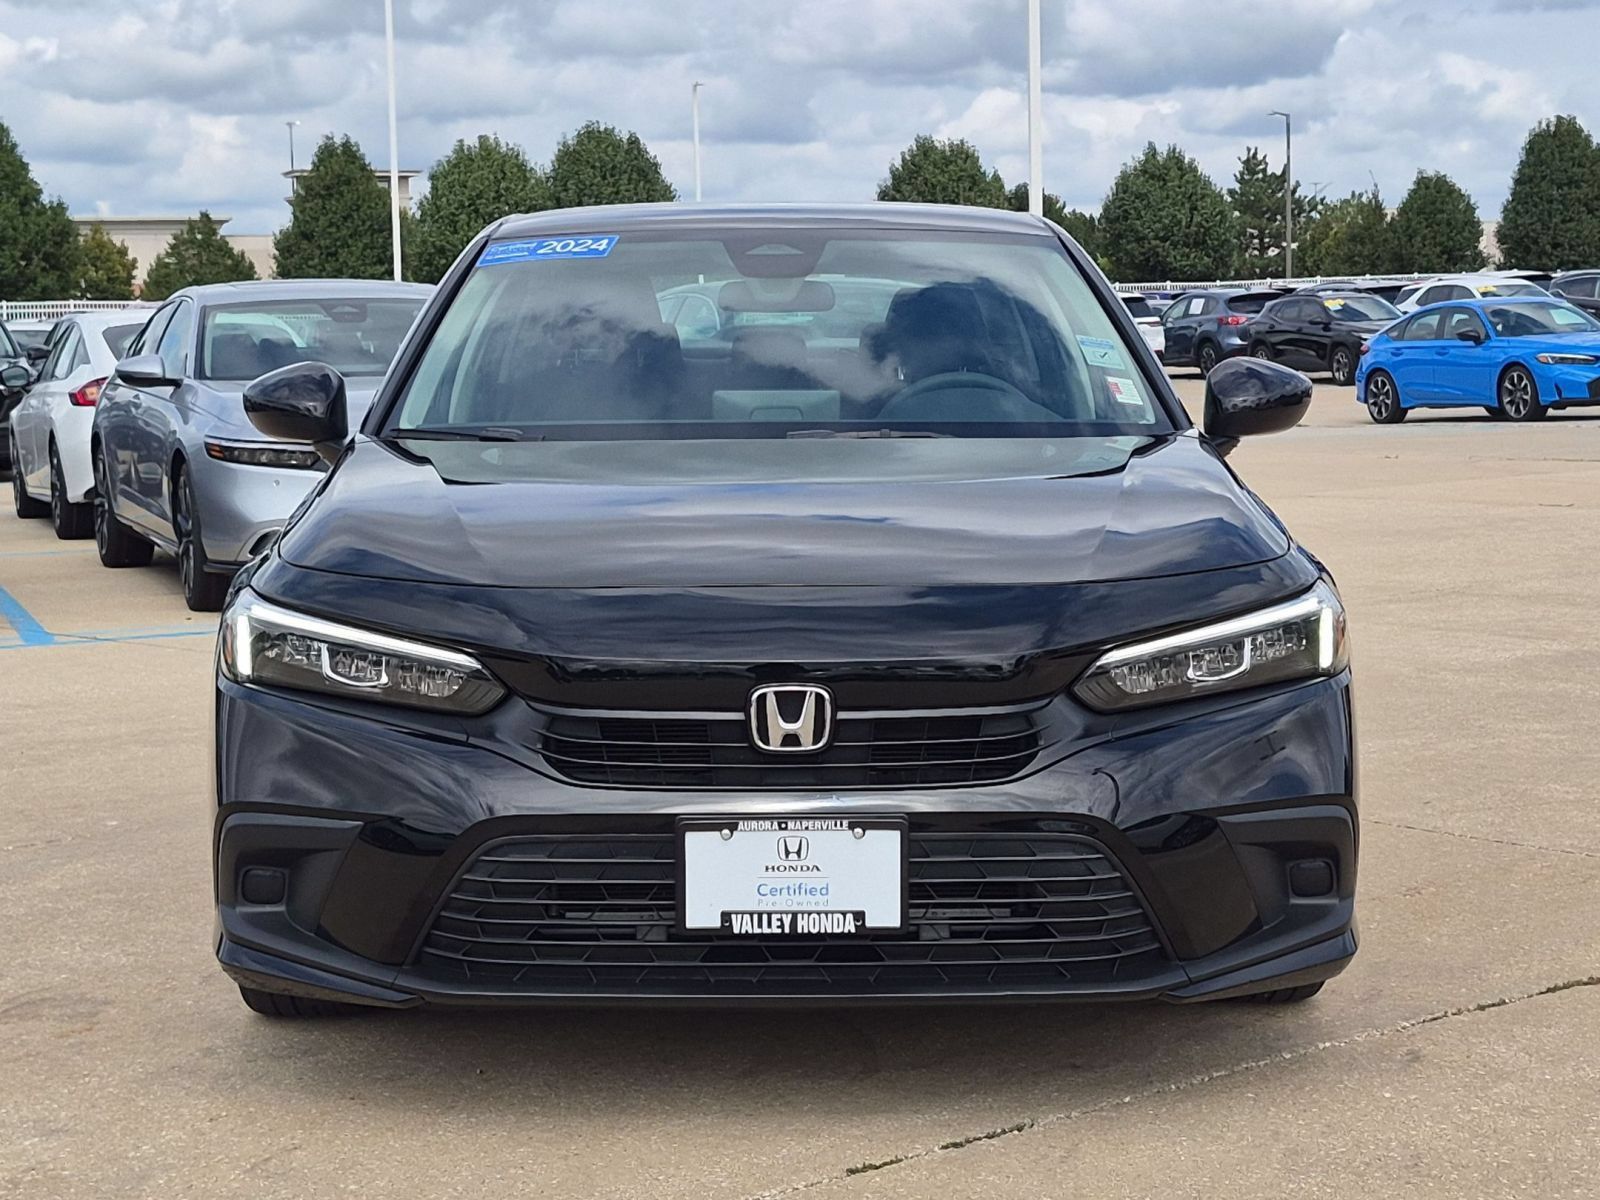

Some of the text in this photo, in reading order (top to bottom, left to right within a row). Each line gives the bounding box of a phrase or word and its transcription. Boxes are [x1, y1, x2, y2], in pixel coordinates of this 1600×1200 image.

[537, 239, 609, 254] 2024
[737, 820, 849, 831] AURORA NAPERVILLE
[764, 864, 822, 873] HONDA
[756, 882, 830, 897] Certified
[731, 913, 856, 934] VALLEY HONDA
